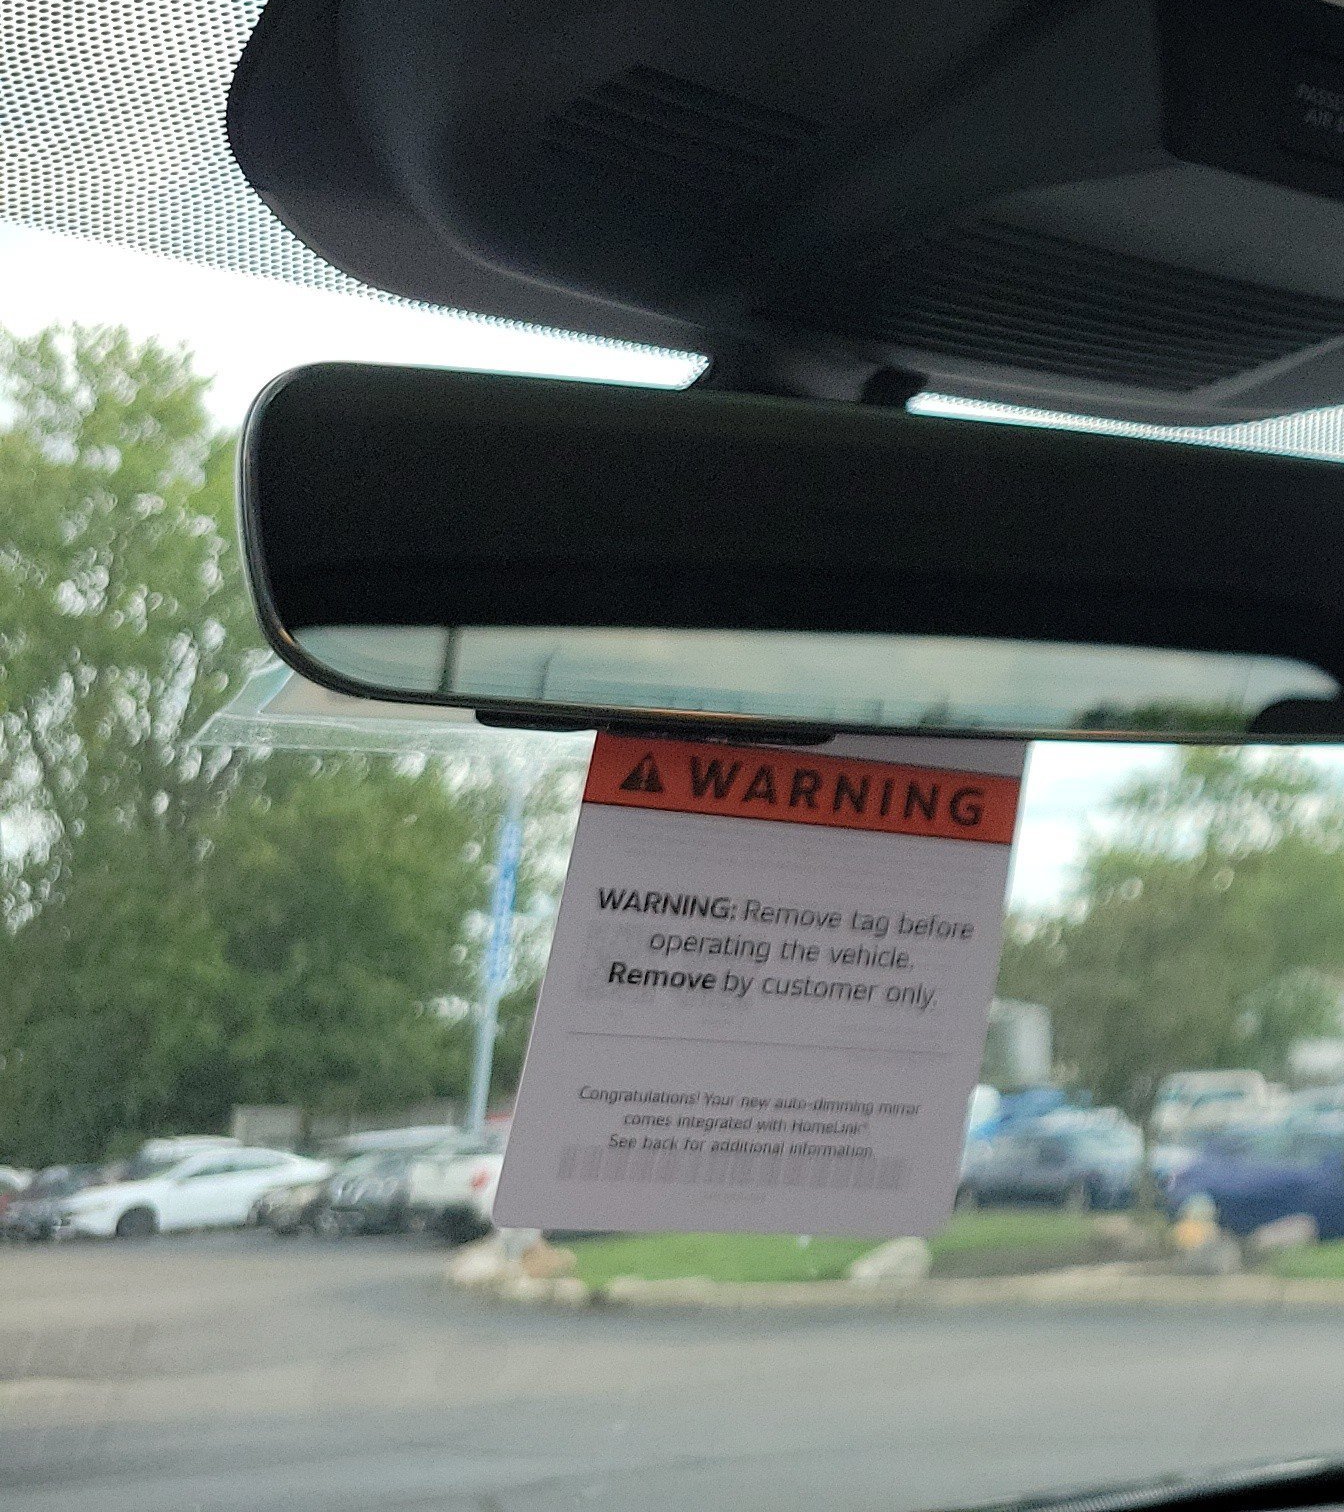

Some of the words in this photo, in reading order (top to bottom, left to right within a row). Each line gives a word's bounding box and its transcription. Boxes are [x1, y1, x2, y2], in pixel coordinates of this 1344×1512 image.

[687, 755, 985, 829] WARNING
[597, 887, 738, 922] WARNING:
[743, 898, 843, 930] Remove
[850, 909, 889, 939] tag
[898, 910, 975, 941] before
[648, 932, 771, 964] operating
[780, 939, 821, 964] the
[828, 942, 916, 971] vehicle.
[607, 961, 717, 991] Remove
[722, 966, 755, 999] by
[760, 972, 876, 1003] customer
[885, 979, 939, 1011] only.
[578, 1085, 700, 1107] Congratulations!
[704, 1092, 735, 1107] Your
[740, 1097, 771, 1109] new
[774, 1095, 874, 1115] auto-dimming
[878, 1102, 922, 1116] mirror
[623, 1114, 670, 1127] comes
[676, 1114, 753, 1131] integrated
[757, 1119, 787, 1133] with
[608, 1134, 636, 1148] See
[643, 1137, 677, 1150] back
[683, 1138, 706, 1151] for
[711, 1140, 785, 1156] additional
[789, 1142, 874, 1159] information.
